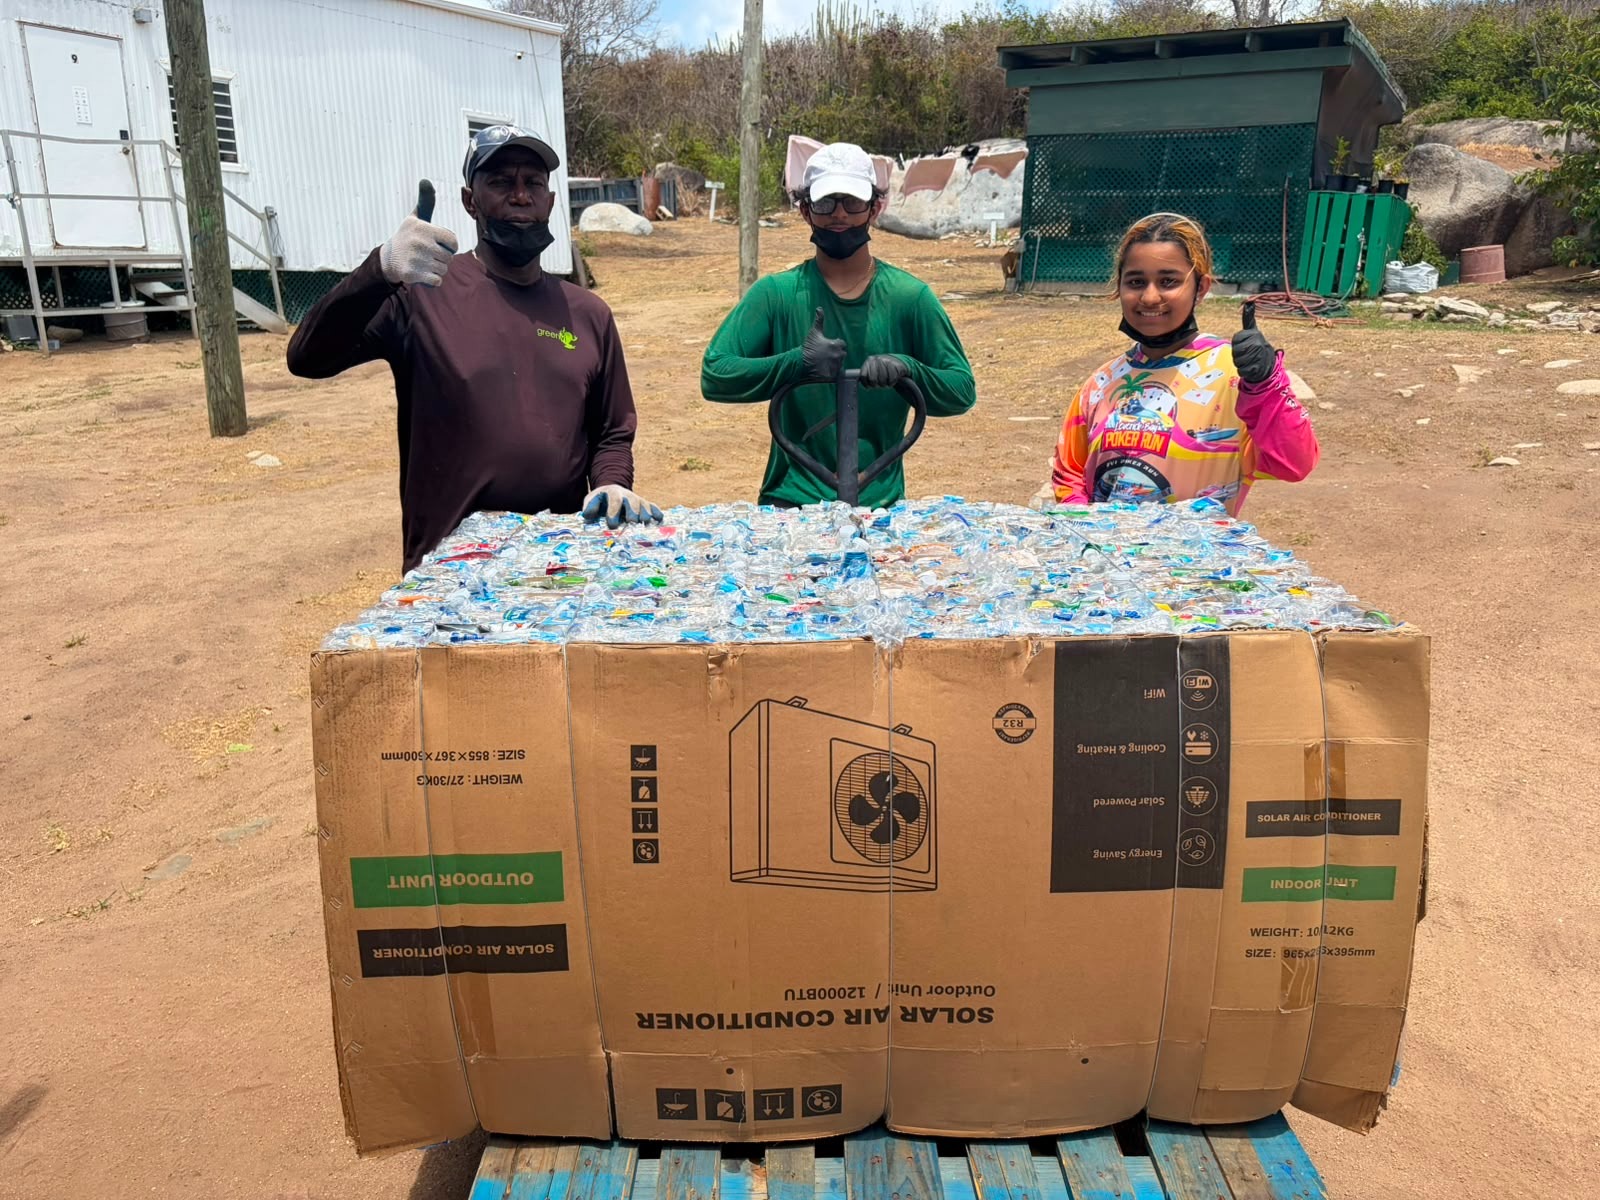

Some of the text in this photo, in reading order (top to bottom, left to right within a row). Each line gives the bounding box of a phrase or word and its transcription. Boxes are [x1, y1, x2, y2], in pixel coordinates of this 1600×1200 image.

[71, 53, 78, 64] 9
[1105, 431, 1165, 453] POKER RUN
[1144, 688, 1166, 699] WiFi
[1002, 719, 1024, 728] R32
[1076, 743, 1166, 754] Cooling & Heating
[416, 774, 464, 786] 27/30KG
[1093, 797, 1165, 808] Solar Powered
[1257, 813, 1290, 823] SOLAR
[1293, 812, 1311, 822] AIR
[1093, 849, 1163, 859] Energy Saving
[387, 872, 534, 889] OUTDOOR UNIT
[1270, 879, 1322, 890] INDOOR
[1250, 927, 1303, 938] WEIGHT:
[372, 943, 555, 959] SOLAR AIR CONDITIONER
[1245, 948, 1277, 958] SIZE:
[784, 985, 866, 1001] 12000BTU
[874, 983, 882, 999] /
[926, 982, 996, 998] Outdoor
[635, 1006, 995, 1030] SOLAR AIR CONDITIONER
